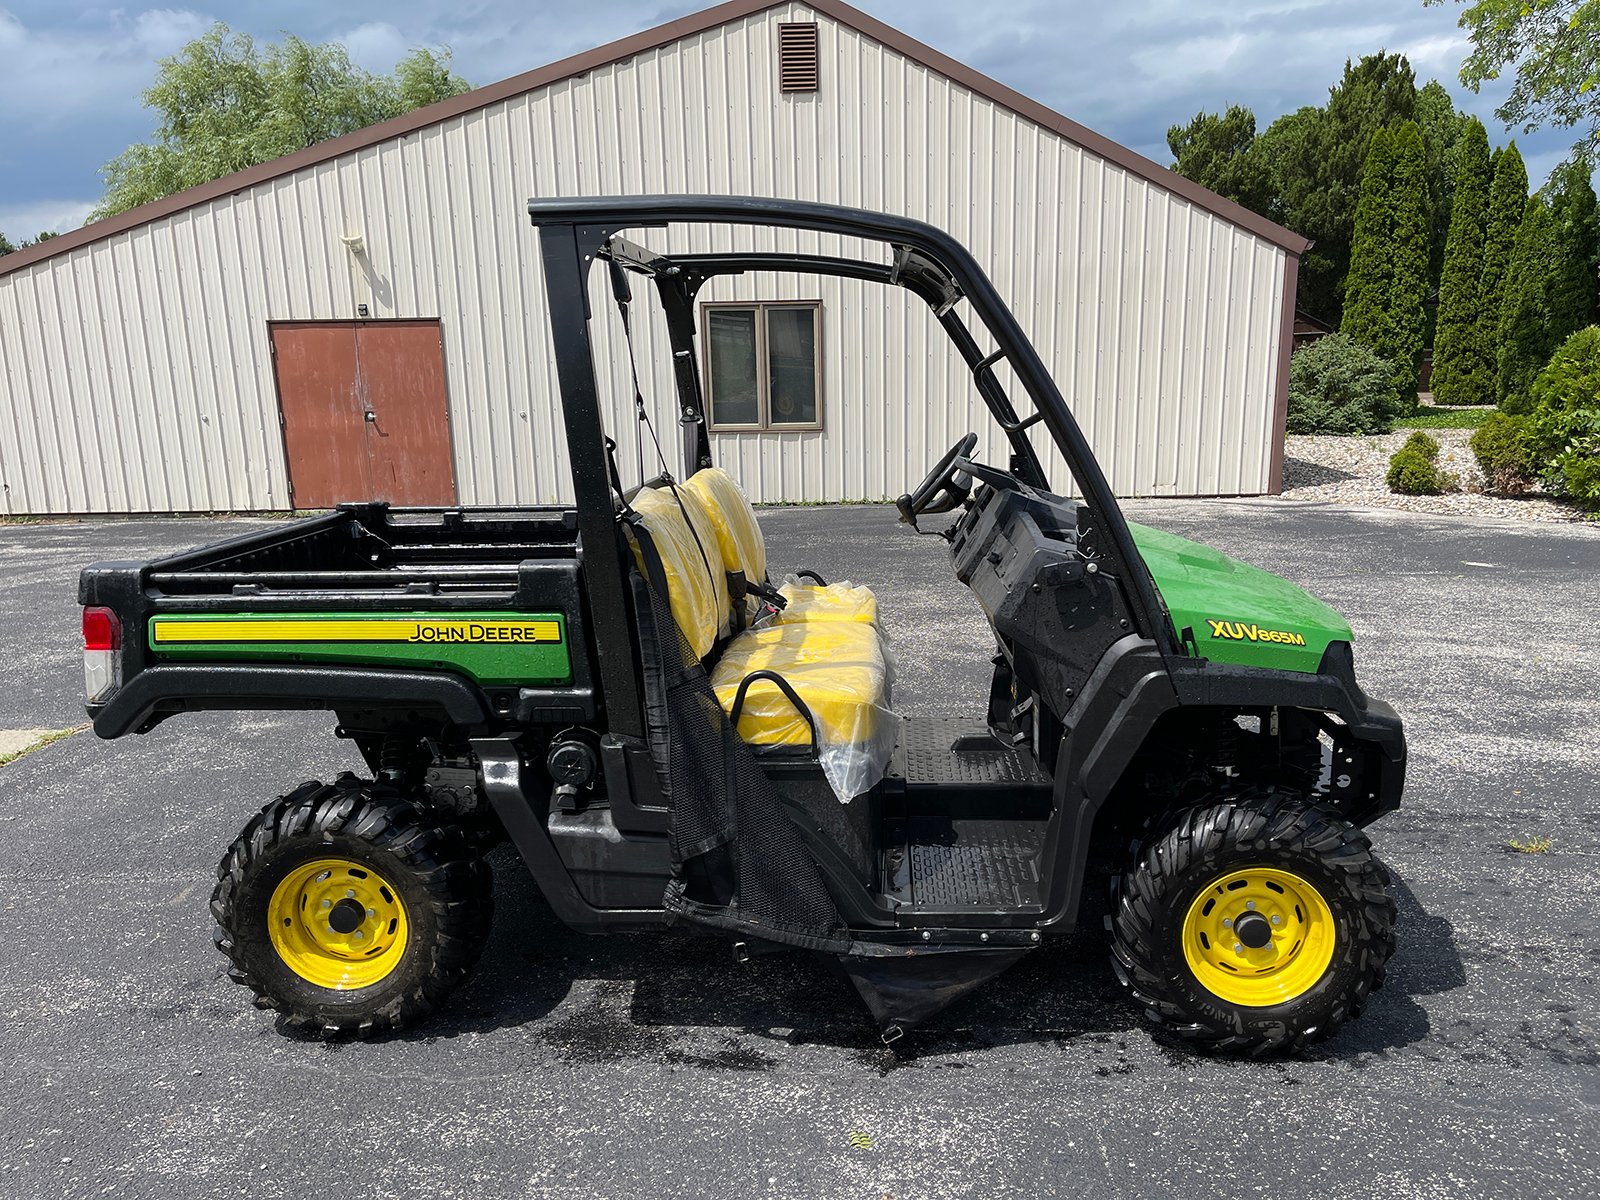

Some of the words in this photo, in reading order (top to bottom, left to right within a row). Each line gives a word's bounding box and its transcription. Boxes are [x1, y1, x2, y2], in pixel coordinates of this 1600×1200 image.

[411, 624, 464, 640] JOHN
[469, 624, 536, 640] DEERE
[1207, 619, 1306, 646] XUV865M
